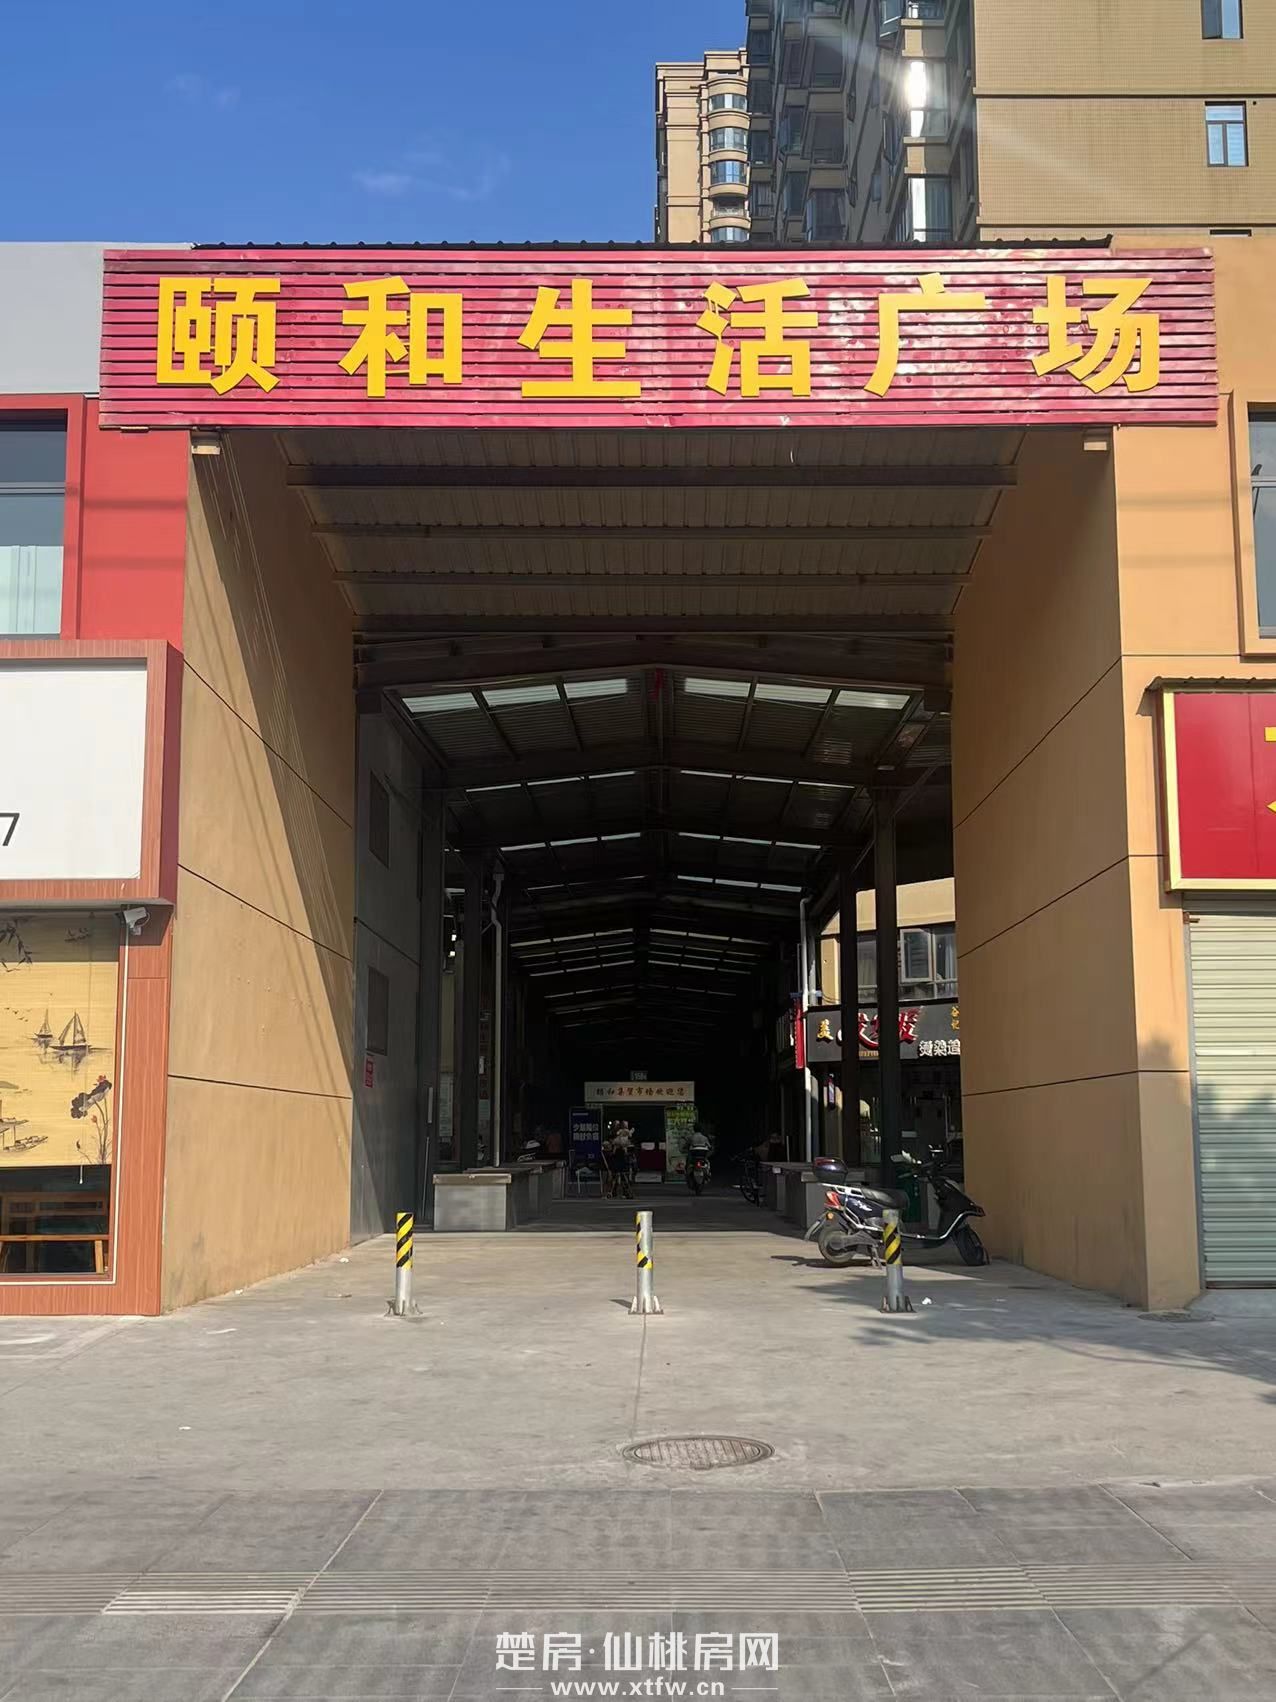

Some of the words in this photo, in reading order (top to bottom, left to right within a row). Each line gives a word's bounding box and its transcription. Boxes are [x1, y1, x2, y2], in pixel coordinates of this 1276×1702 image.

[156, 272, 1163, 399] 颐和生活广场
